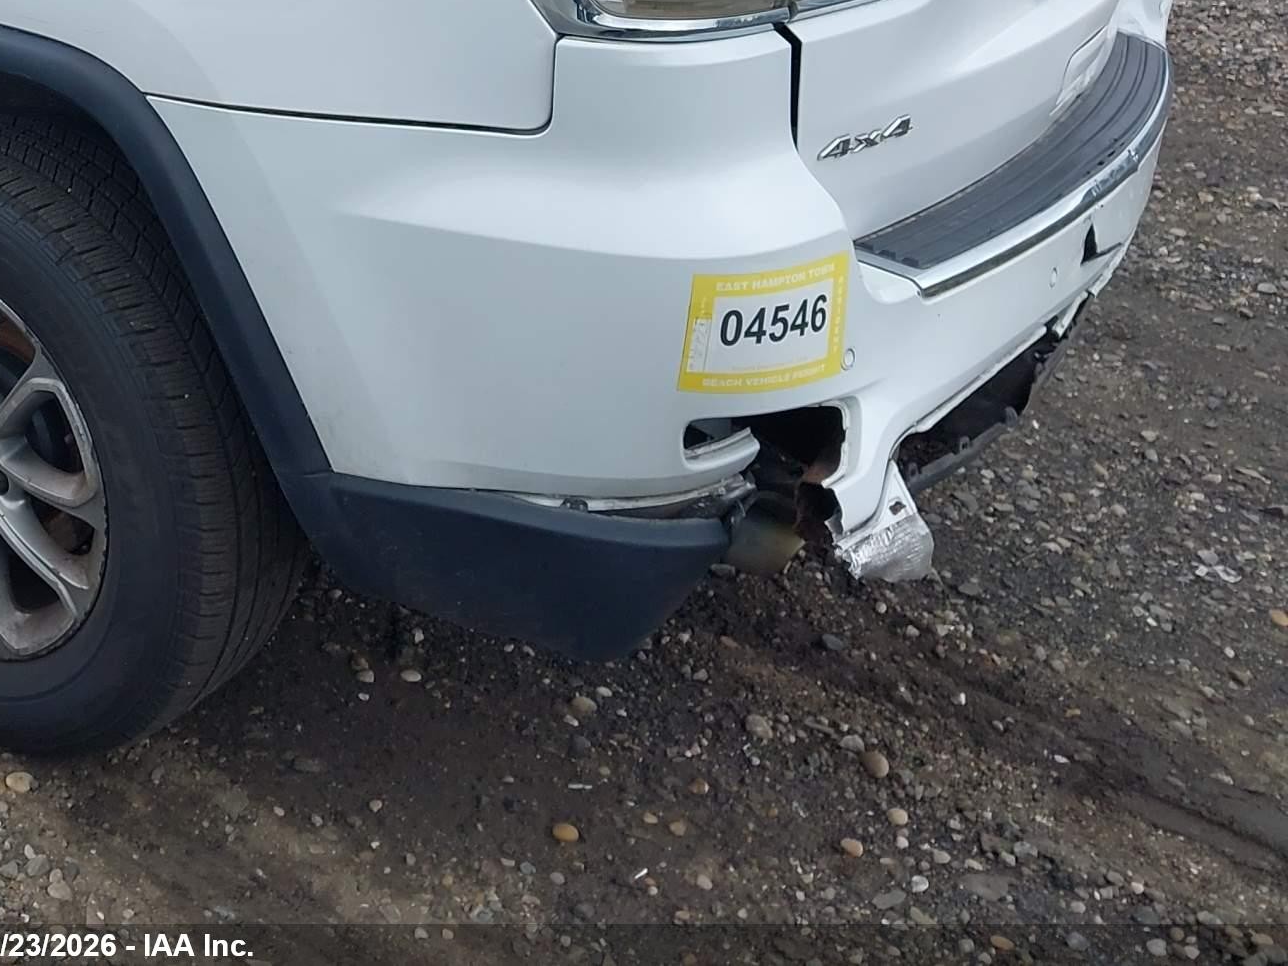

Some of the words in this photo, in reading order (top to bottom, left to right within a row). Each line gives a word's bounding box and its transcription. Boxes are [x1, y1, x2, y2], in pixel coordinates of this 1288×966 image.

[817, 114, 913, 161] 4x4
[715, 281, 748, 291] EAST
[752, 271, 807, 290] HAMPTON
[720, 294, 828, 347] 04546
